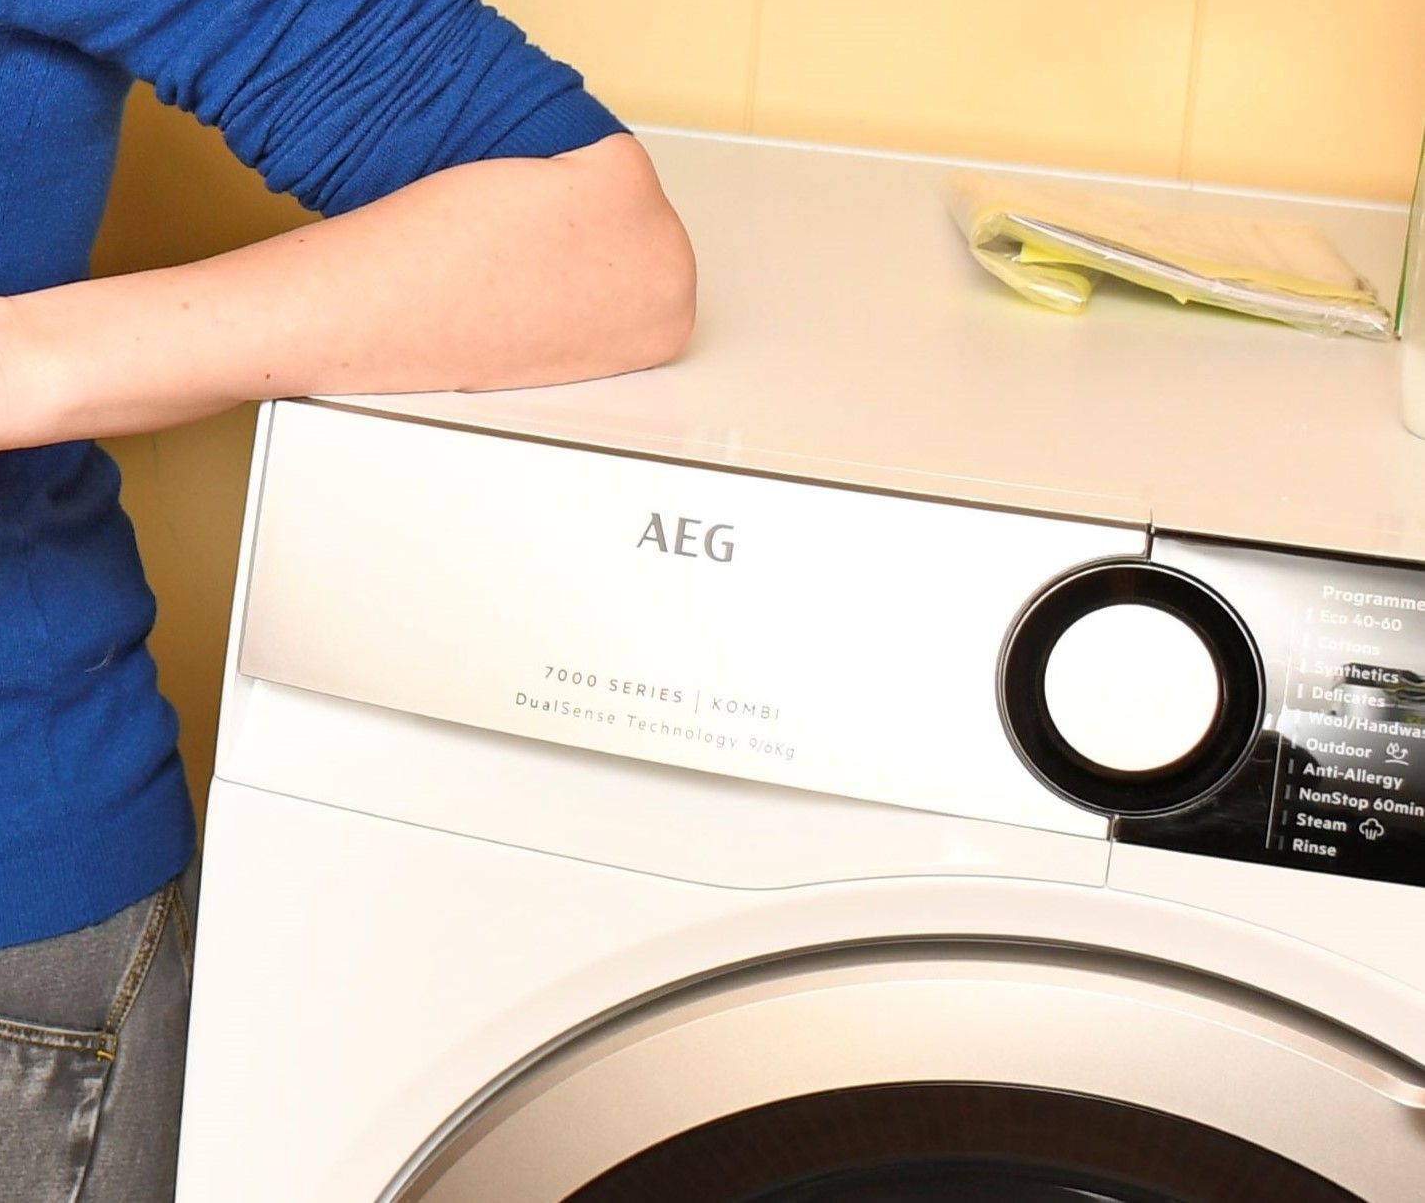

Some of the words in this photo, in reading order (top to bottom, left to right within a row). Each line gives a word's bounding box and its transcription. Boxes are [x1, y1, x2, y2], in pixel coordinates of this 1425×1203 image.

[636, 511, 735, 563] AEG
[1322, 585, 1425, 611] Programme
[1320, 610, 1348, 625] Eco
[1353, 614, 1403, 631] 40-60
[1318, 636, 1382, 656] Cottons
[1316, 661, 1400, 683] Synthetics
[544, 666, 598, 688] 7000
[608, 679, 683, 703] SERIES
[711, 697, 780, 720] KOMBI
[1312, 686, 1386, 708] Delicates
[515, 692, 617, 724] DualSense
[626, 714, 738, 749] Technology
[1306, 738, 1373, 759] Outdoor
[1303, 762, 1404, 791] Anti-Allergy
[1298, 787, 1369, 811] NonStop
[1373, 797, 1425, 817] 60min
[1296, 813, 1348, 832] Steam
[1292, 838, 1337, 857] Rinse
